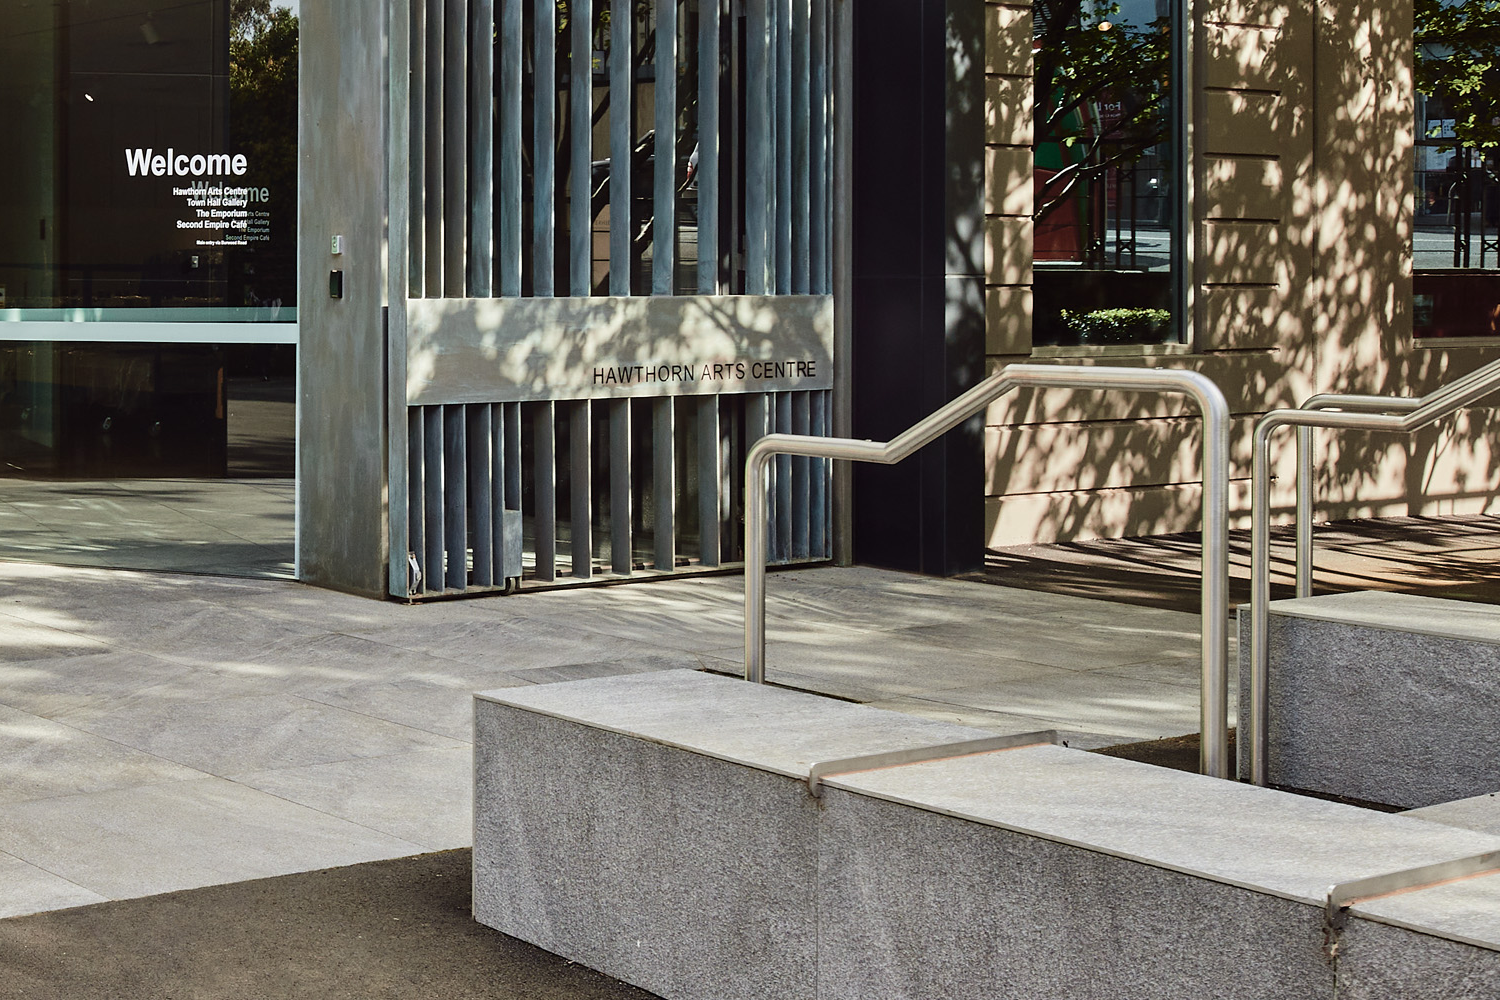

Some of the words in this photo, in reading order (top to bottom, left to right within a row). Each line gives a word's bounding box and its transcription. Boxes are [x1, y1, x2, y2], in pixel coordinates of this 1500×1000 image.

[125, 148, 247, 176] Welcome
[172, 187, 206, 195] Hawthorn
[207, 187, 222, 195] Arts
[223, 187, 248, 195] Centre
[187, 198, 206, 206] Town
[207, 198, 221, 206] Hall
[222, 198, 248, 208] Gallery
[196, 209, 210, 217] The
[211, 209, 248, 219] Emporium
[176, 220, 204, 229] Second
[204, 220, 230, 230] Empire
[230, 219, 248, 229] Café
[593, 364, 695, 384] HAWTHORN
[701, 362, 745, 381] ARTS
[752, 361, 816, 379] CENTRE
